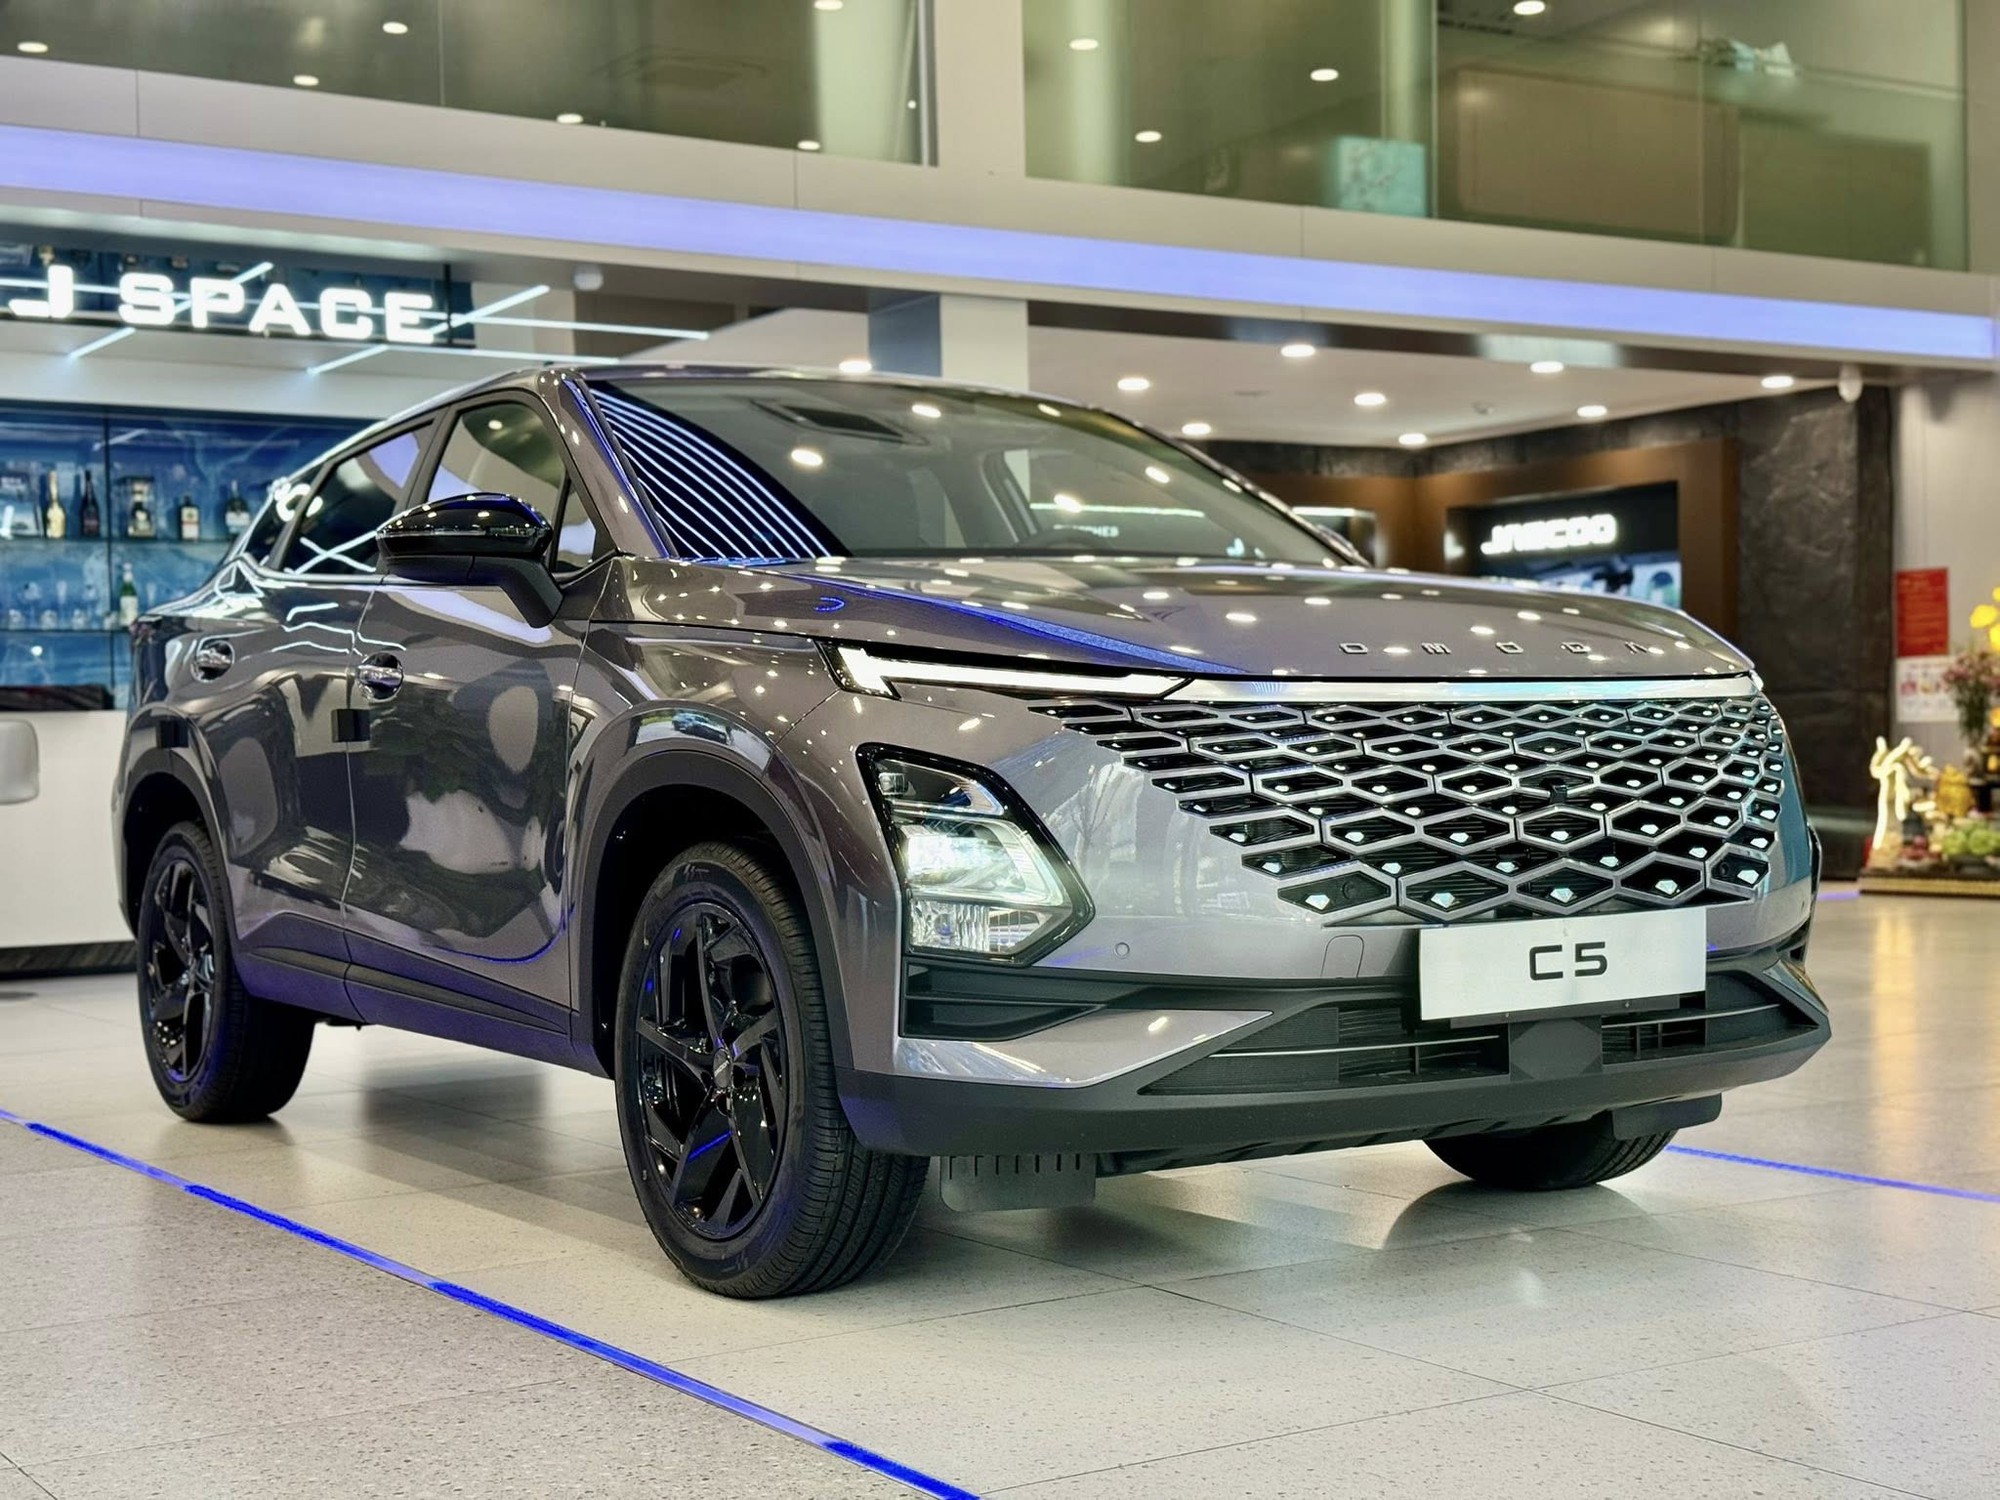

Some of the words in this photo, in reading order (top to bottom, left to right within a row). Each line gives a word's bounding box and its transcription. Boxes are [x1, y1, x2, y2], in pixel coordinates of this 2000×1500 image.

[9, 265, 73, 318] J
[119, 272, 435, 344] SPACE
[1529, 941, 1608, 981] C5
